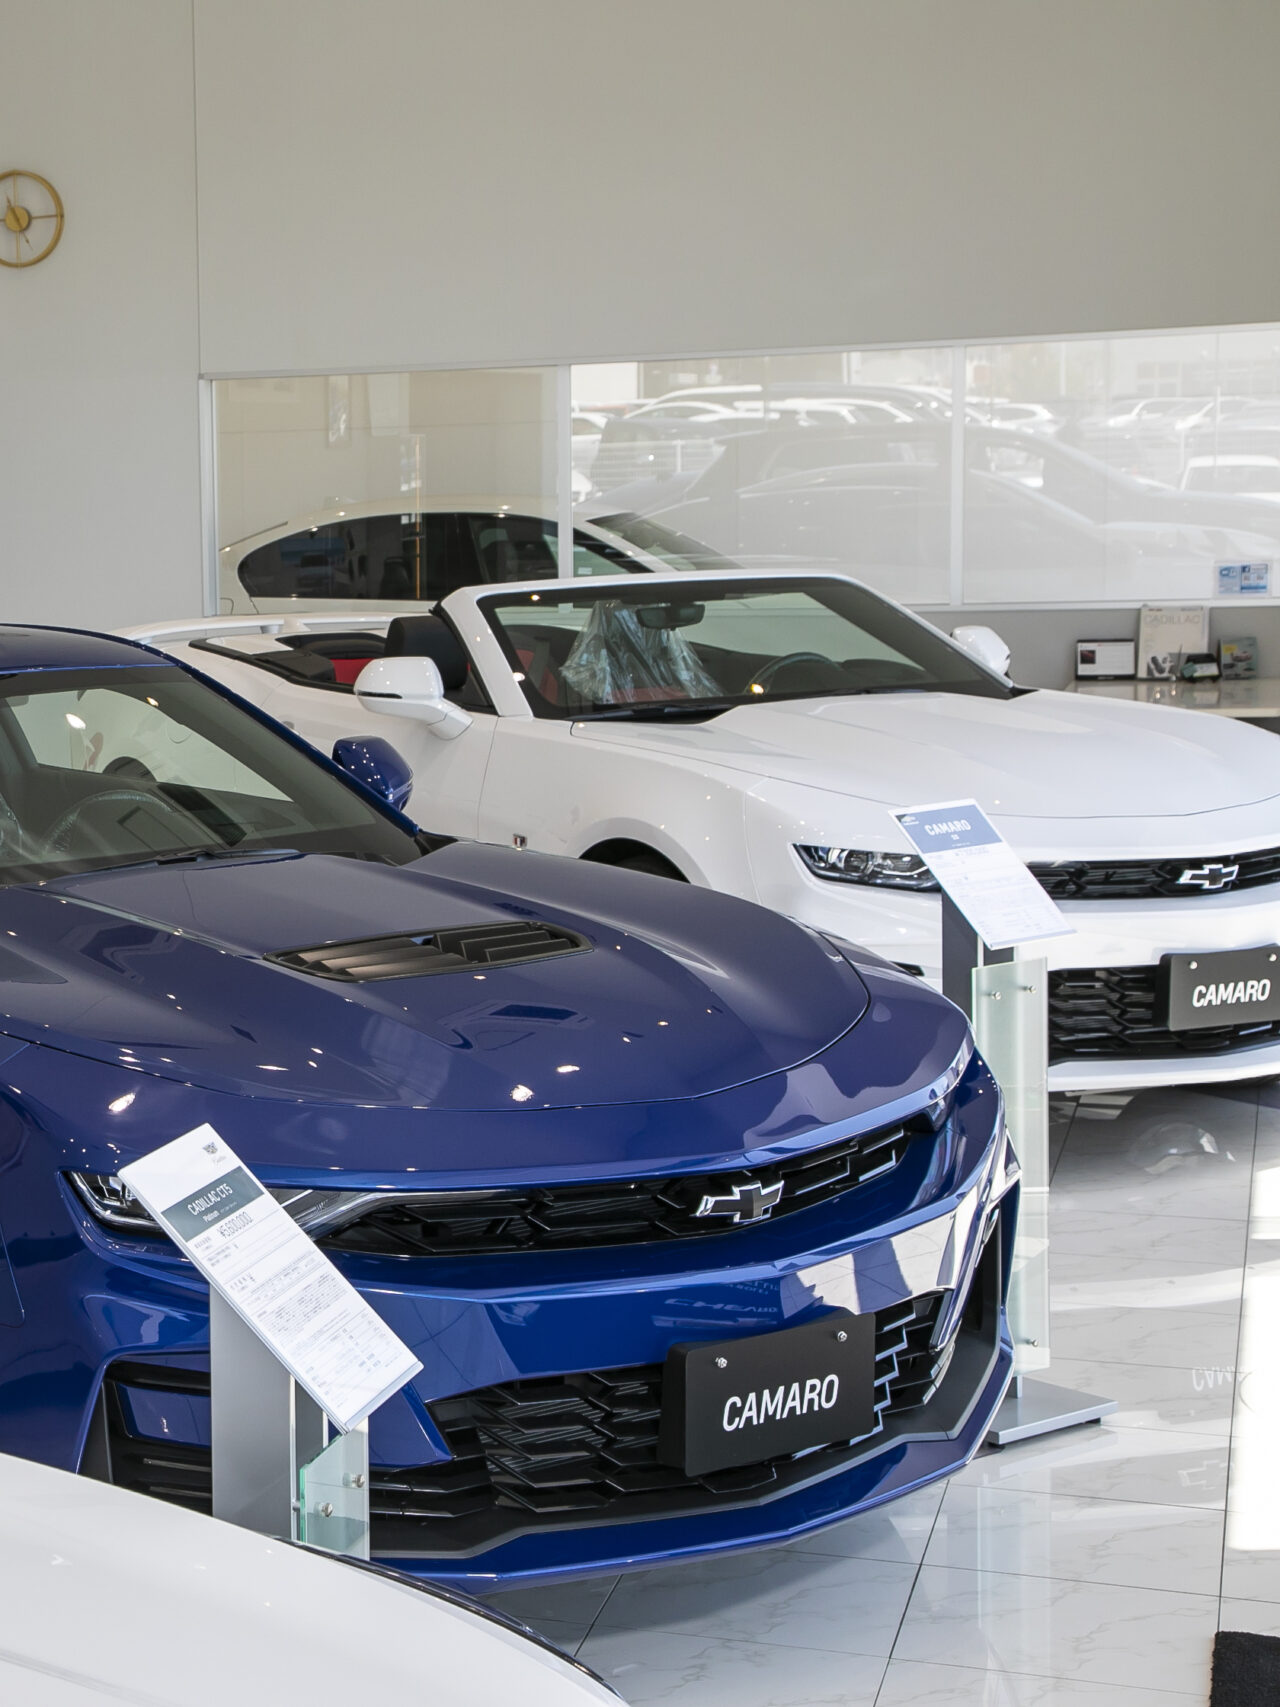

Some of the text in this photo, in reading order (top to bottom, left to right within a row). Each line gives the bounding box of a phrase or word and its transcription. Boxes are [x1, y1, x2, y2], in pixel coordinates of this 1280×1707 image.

[1143, 614, 1201, 625] CADILLAC
[924, 819, 972, 836] CAMARO
[1192, 978, 1271, 1008] CAMARO
[187, 1191, 220, 1216] CADILLAC
[721, 1373, 840, 1433] CAMARO
